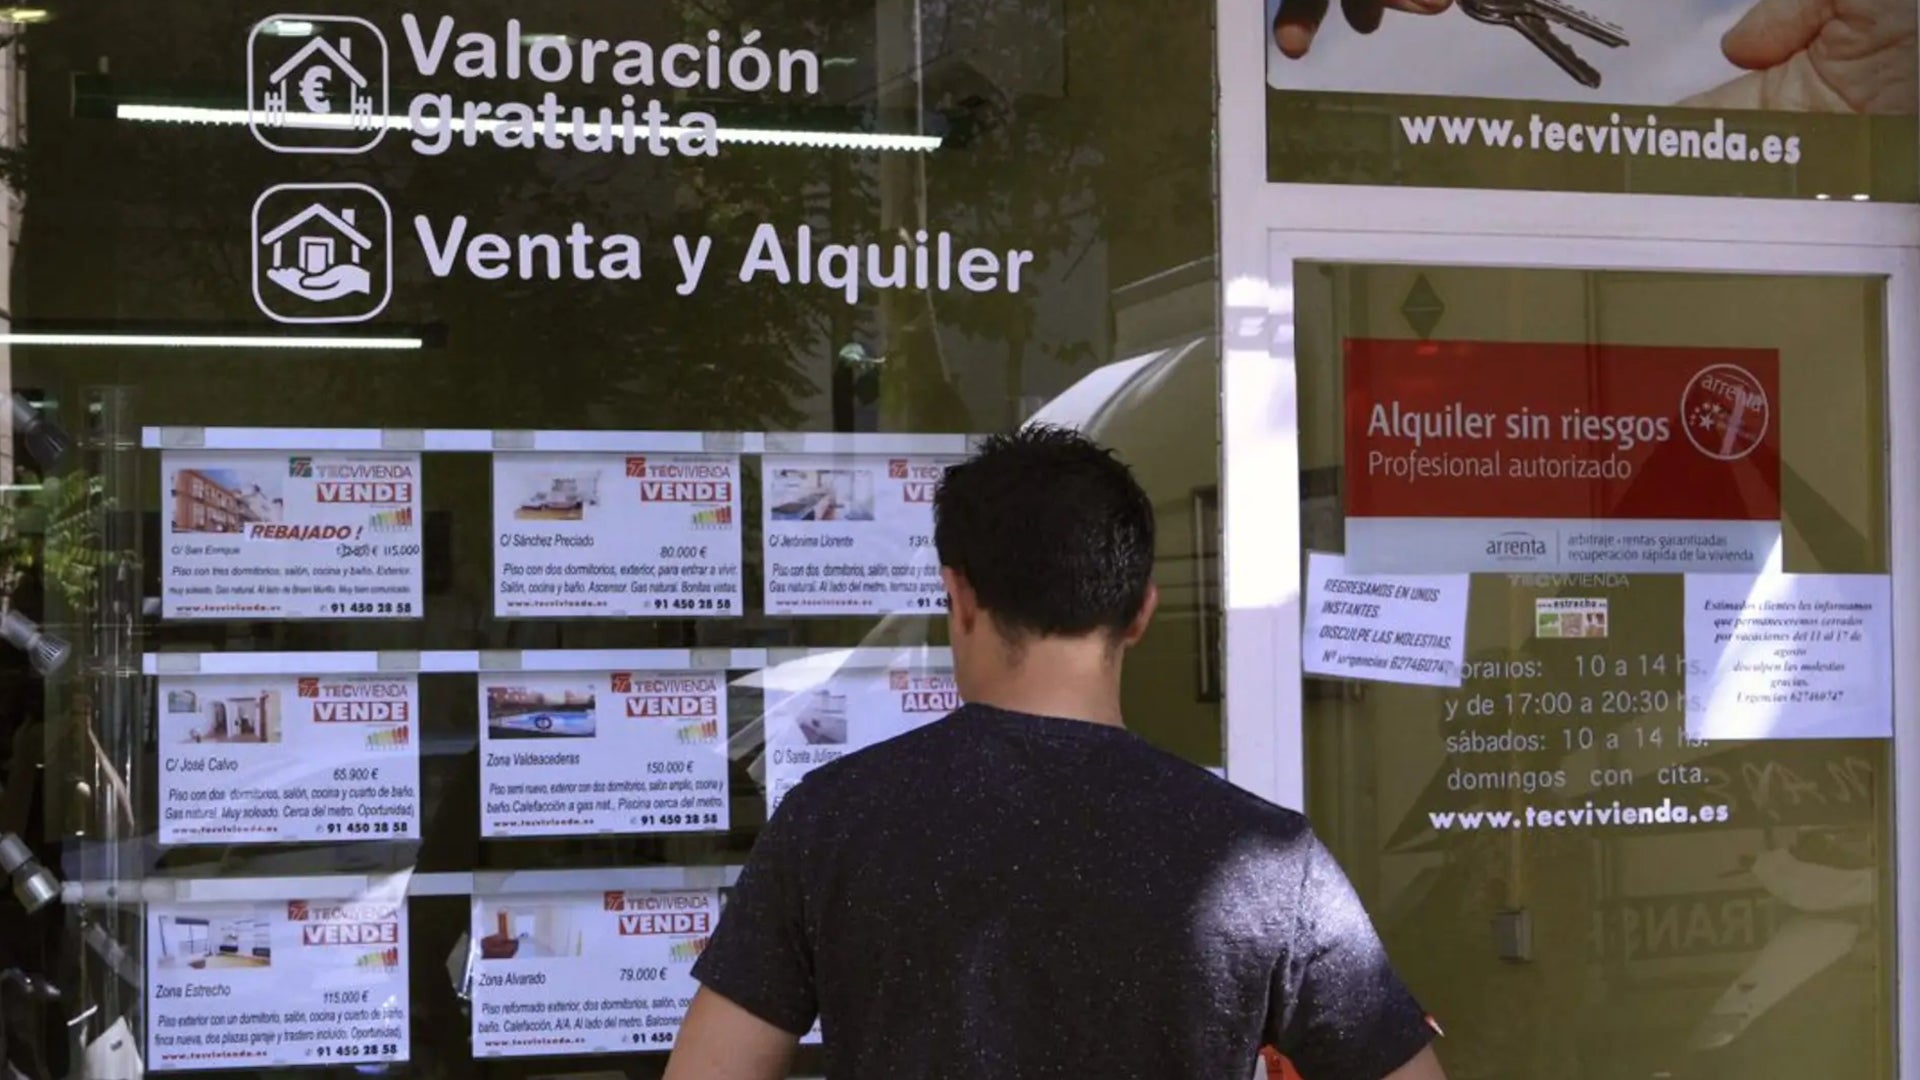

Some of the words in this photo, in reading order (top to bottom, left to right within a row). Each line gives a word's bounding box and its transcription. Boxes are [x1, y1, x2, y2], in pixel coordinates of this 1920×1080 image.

[402, 13, 818, 94] Valoración
[409, 90, 719, 157] gratuita
[1401, 112, 1801, 164] www.tecvivienda.es
[415, 214, 641, 280] Venta
[673, 235, 712, 295] y
[740, 223, 1034, 303] Alquiler
[1367, 403, 1495, 446] Alquiler
[1505, 408, 1550, 439] sin
[1561, 410, 1669, 450] riesgos
[317, 465, 412, 478] TECVIVIENDA
[650, 465, 730, 478] TECVIVIENDA
[1368, 450, 1501, 482] Profesional
[1509, 454, 1631, 479] autorizado
[319, 484, 410, 501] VENDE
[642, 484, 729, 500] VENDE
[250, 525, 351, 541] REBAJADO
[500, 534, 512, 547] C/
[512, 534, 552, 547] Sánchez
[554, 534, 594, 547] Preciado
[1486, 538, 1546, 555] arrenta
[1568, 535, 1614, 549] arbitraje
[1623, 536, 1654, 546] rentas
[660, 546, 697, 558] 80.000
[699, 545, 707, 558] €
[1568, 549, 1639, 563] recuperación
[1643, 549, 1670, 563] rápida
[1673, 549, 1691, 561] de
[1695, 549, 1706, 561] la
[1708, 550, 1754, 562] vivienda
[503, 563, 524, 576] Piso
[564, 563, 617, 576] dormitorios,
[658, 566, 679, 577] para
[681, 564, 708, 576] entrar
[528, 581, 555, 593] cocina
[681, 581, 711, 593] Bonitas
[1323, 578, 1395, 598] REGRESAMOS
[1394, 585, 1411, 600] EN
[1410, 587, 1441, 602] UNOS
[331, 603, 345, 613] 91
[350, 603, 374, 613] 450
[377, 603, 393, 613] 28
[396, 603, 412, 613] 58
[654, 599, 668, 609] 91
[672, 599, 695, 609] 450
[698, 599, 713, 609] 28
[716, 599, 731, 609] 58
[917, 597, 931, 608] 91
[1798, 601, 1812, 611] les
[1813, 601, 1873, 614] informamos
[1713, 618, 1733, 629] que
[1821, 616, 1863, 626] cerrados
[1319, 624, 1372, 643] DISCULPE
[1371, 630, 1394, 645] LAS
[1714, 633, 1733, 644] por
[1792, 631, 1809, 642] del
[1823, 631, 1834, 641] al
[1850, 631, 1862, 641] de
[1337, 655, 1389, 668] urgencias
[1575, 654, 1606, 677] 10
[1615, 661, 1628, 676] a
[1639, 654, 1666, 674] 14
[1800, 661, 1845, 672] molestias
[323, 684, 408, 698] TECVIVIENDA
[635, 680, 717, 693] TECVIVIENDA
[315, 702, 407, 721] VENDE
[627, 697, 715, 715] VENDE
[1445, 699, 1459, 721] y
[1467, 694, 1494, 716] de
[1504, 692, 1572, 714] 17:00
[1580, 698, 1593, 714] a
[1602, 691, 1669, 713] 20:30
[1447, 730, 1546, 753] sábados:
[1563, 727, 1594, 750] 10
[1606, 732, 1619, 749] a
[1635, 726, 1663, 747] 14
[1678, 726, 1709, 748] hs.
[166, 758, 179, 772] C/
[180, 757, 205, 772] José
[208, 757, 239, 771] Calvo
[487, 753, 511, 767] Zona
[513, 752, 580, 766] Valdeacederas
[333, 768, 370, 781] 65.900
[371, 767, 379, 780] €
[647, 761, 685, 774] 150.000
[686, 760, 694, 773] €
[1447, 767, 1567, 793] domingos
[1590, 768, 1633, 787] con
[1657, 763, 1710, 785] cita.
[169, 788, 188, 801] Piso
[311, 788, 340, 799] cocina
[348, 787, 377, 799] cuarto
[283, 805, 310, 817] Cerca
[513, 800, 566, 813] Calefacción
[1428, 798, 1729, 829] www.tecvivienda.es
[641, 815, 654, 825] 91
[659, 815, 682, 825] 450
[685, 814, 700, 824] 28
[703, 813, 718, 824] 58
[327, 823, 342, 833] 91
[346, 823, 370, 833] 450
[374, 822, 389, 832] 28
[392, 822, 408, 832] 58
[628, 896, 709, 910] TECVIVIENDA
[620, 914, 708, 934] VENDE
[305, 923, 395, 944] VENDE
[479, 973, 503, 987] Zona
[505, 972, 547, 985] Alvarado
[620, 968, 657, 981] 79.000
[659, 967, 668, 980] €
[155, 984, 183, 999] Zona
[185, 983, 231, 998] Estrecho
[482, 1003, 501, 1014] Piso
[502, 1001, 546, 1013] reformado
[309, 1011, 336, 1022] cocina
[632, 1033, 646, 1044] 91
[651, 1032, 673, 1043] 450
[316, 1046, 331, 1057] 91
[336, 1045, 359, 1056] 450
[363, 1045, 378, 1055] 28
[382, 1044, 397, 1055] 58
